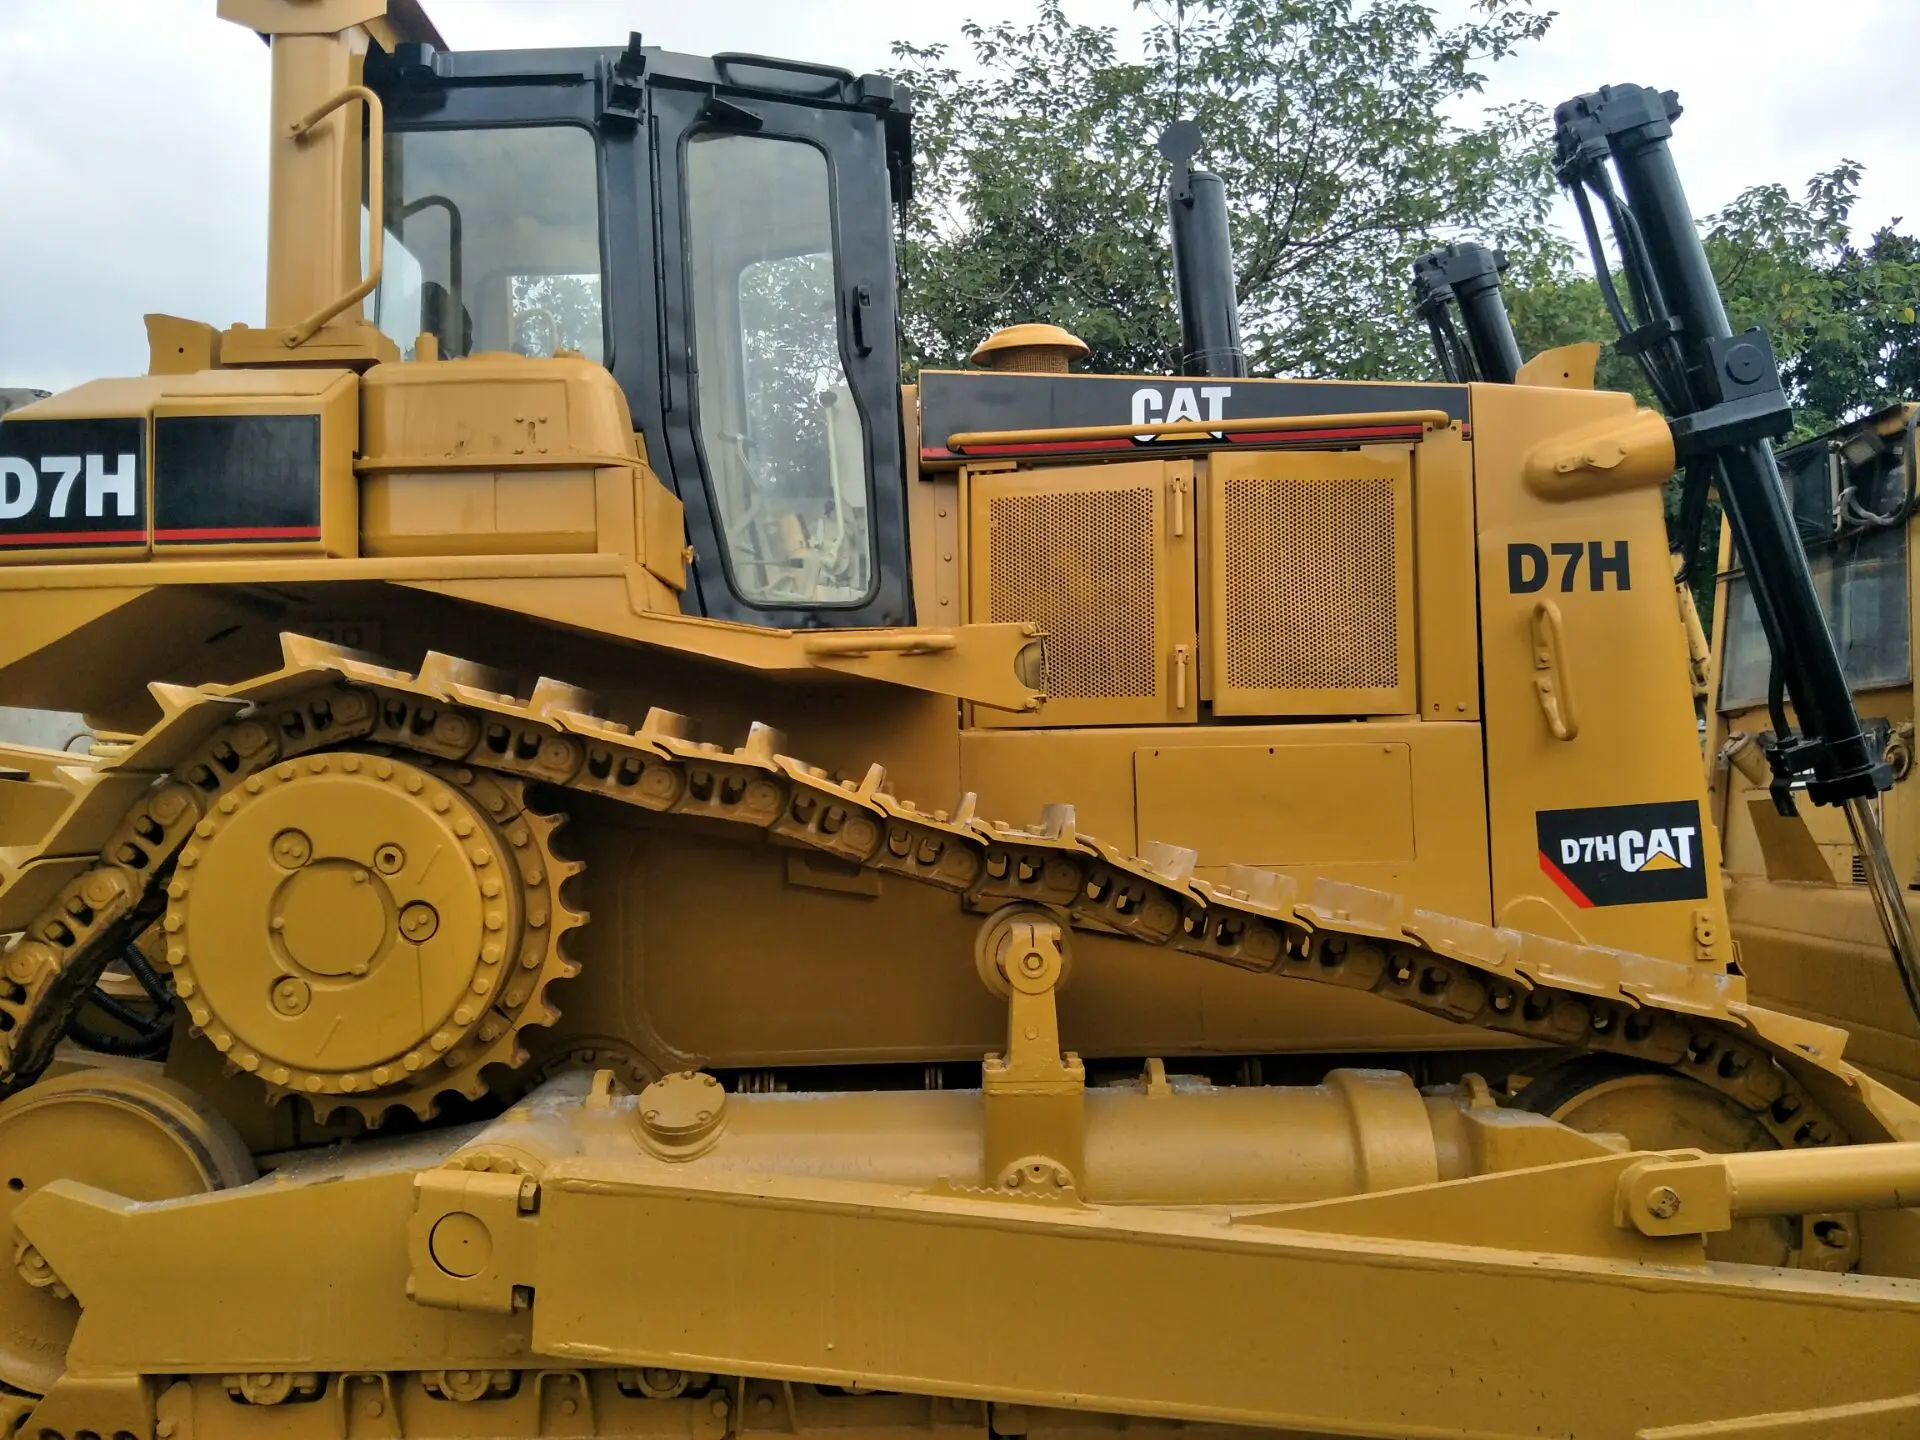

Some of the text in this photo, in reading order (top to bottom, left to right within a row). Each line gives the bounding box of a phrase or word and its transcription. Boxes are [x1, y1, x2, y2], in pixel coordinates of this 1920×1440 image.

[1131, 386, 1232, 442] CAT
[0, 454, 136, 518] D7H
[1507, 540, 1631, 595] D7H
[1559, 826, 1695, 873] D7H CAT
